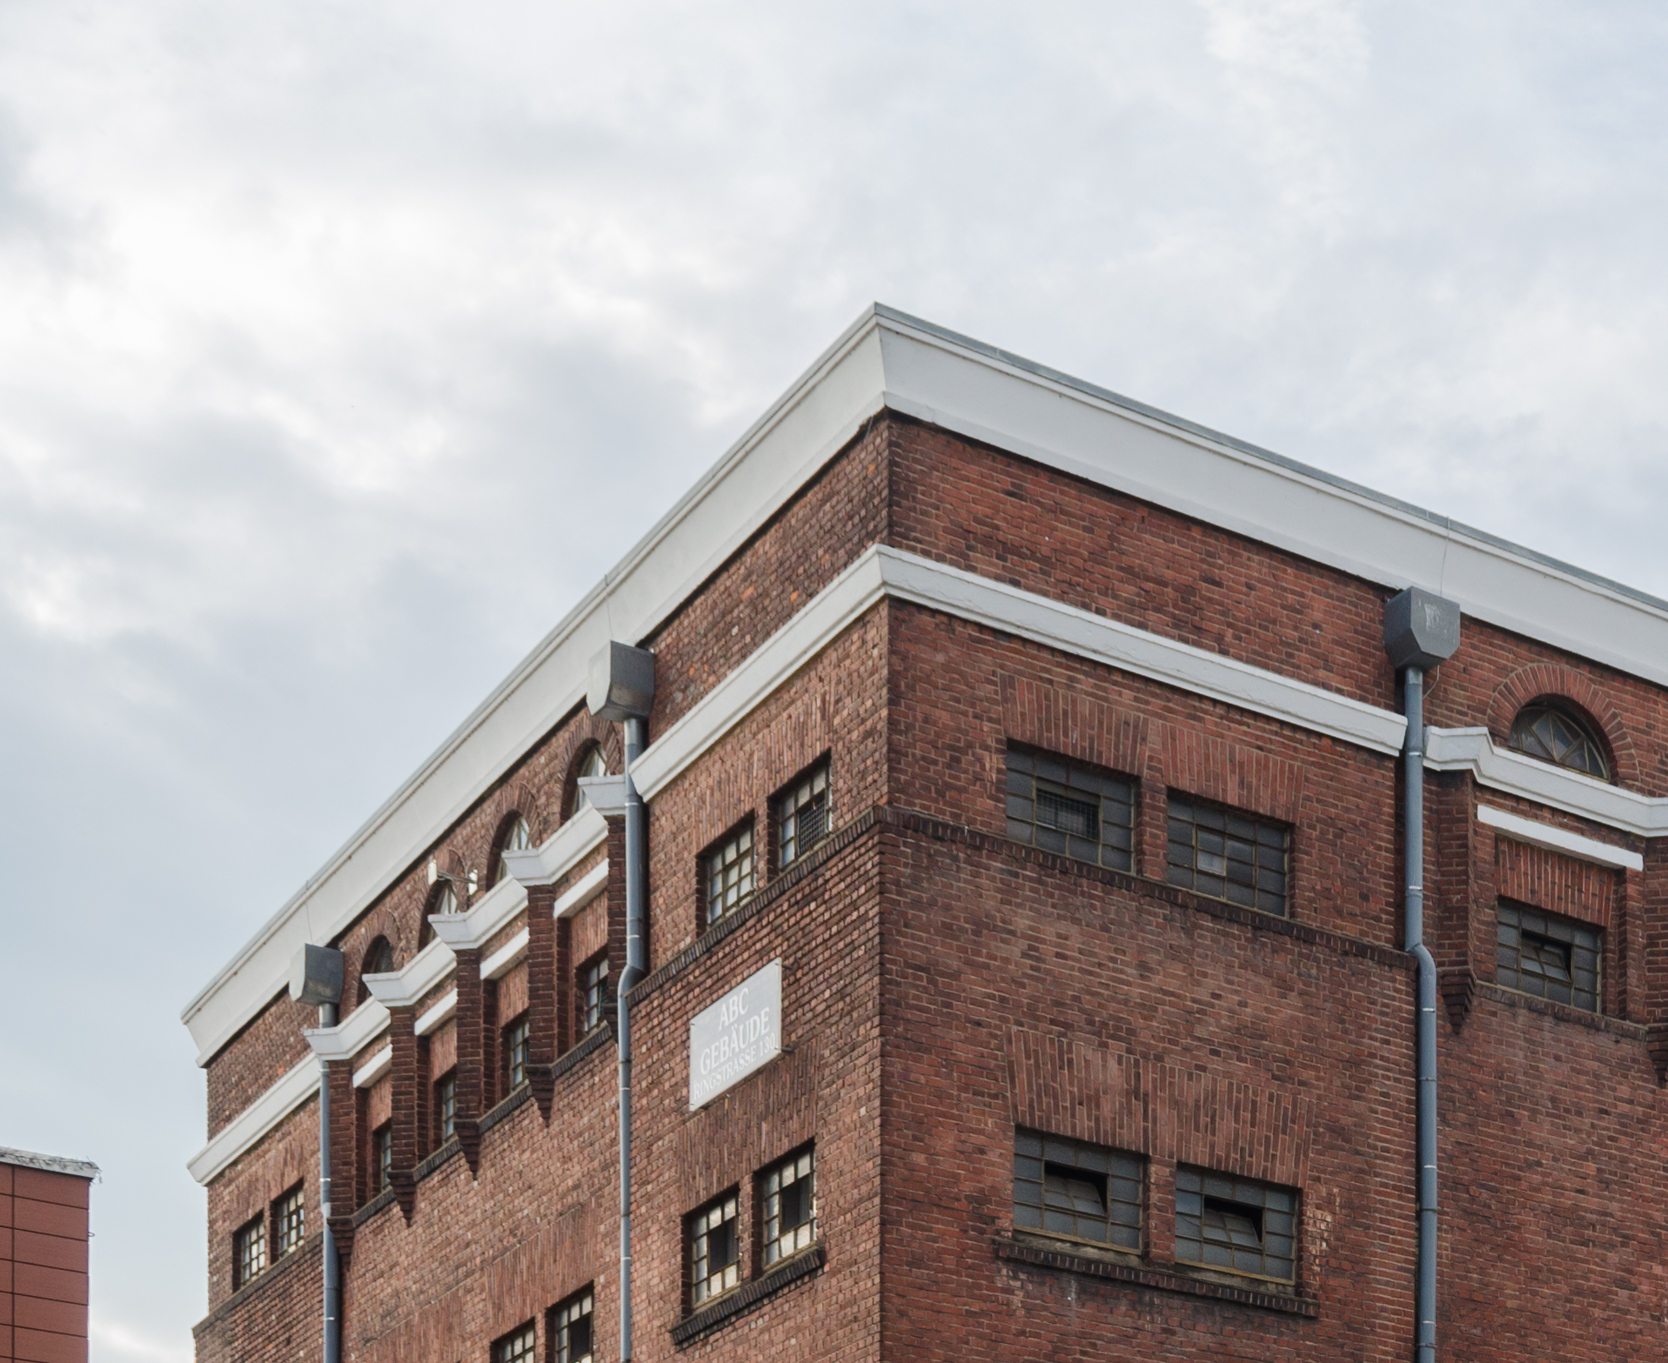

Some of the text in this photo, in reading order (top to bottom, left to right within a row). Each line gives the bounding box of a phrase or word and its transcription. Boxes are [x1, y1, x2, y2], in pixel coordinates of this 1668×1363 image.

[719, 987, 749, 1031] ABC
[700, 1006, 770, 1075] GEBÄUDE
[693, 1045, 757, 1101] RINGSTRASSE
